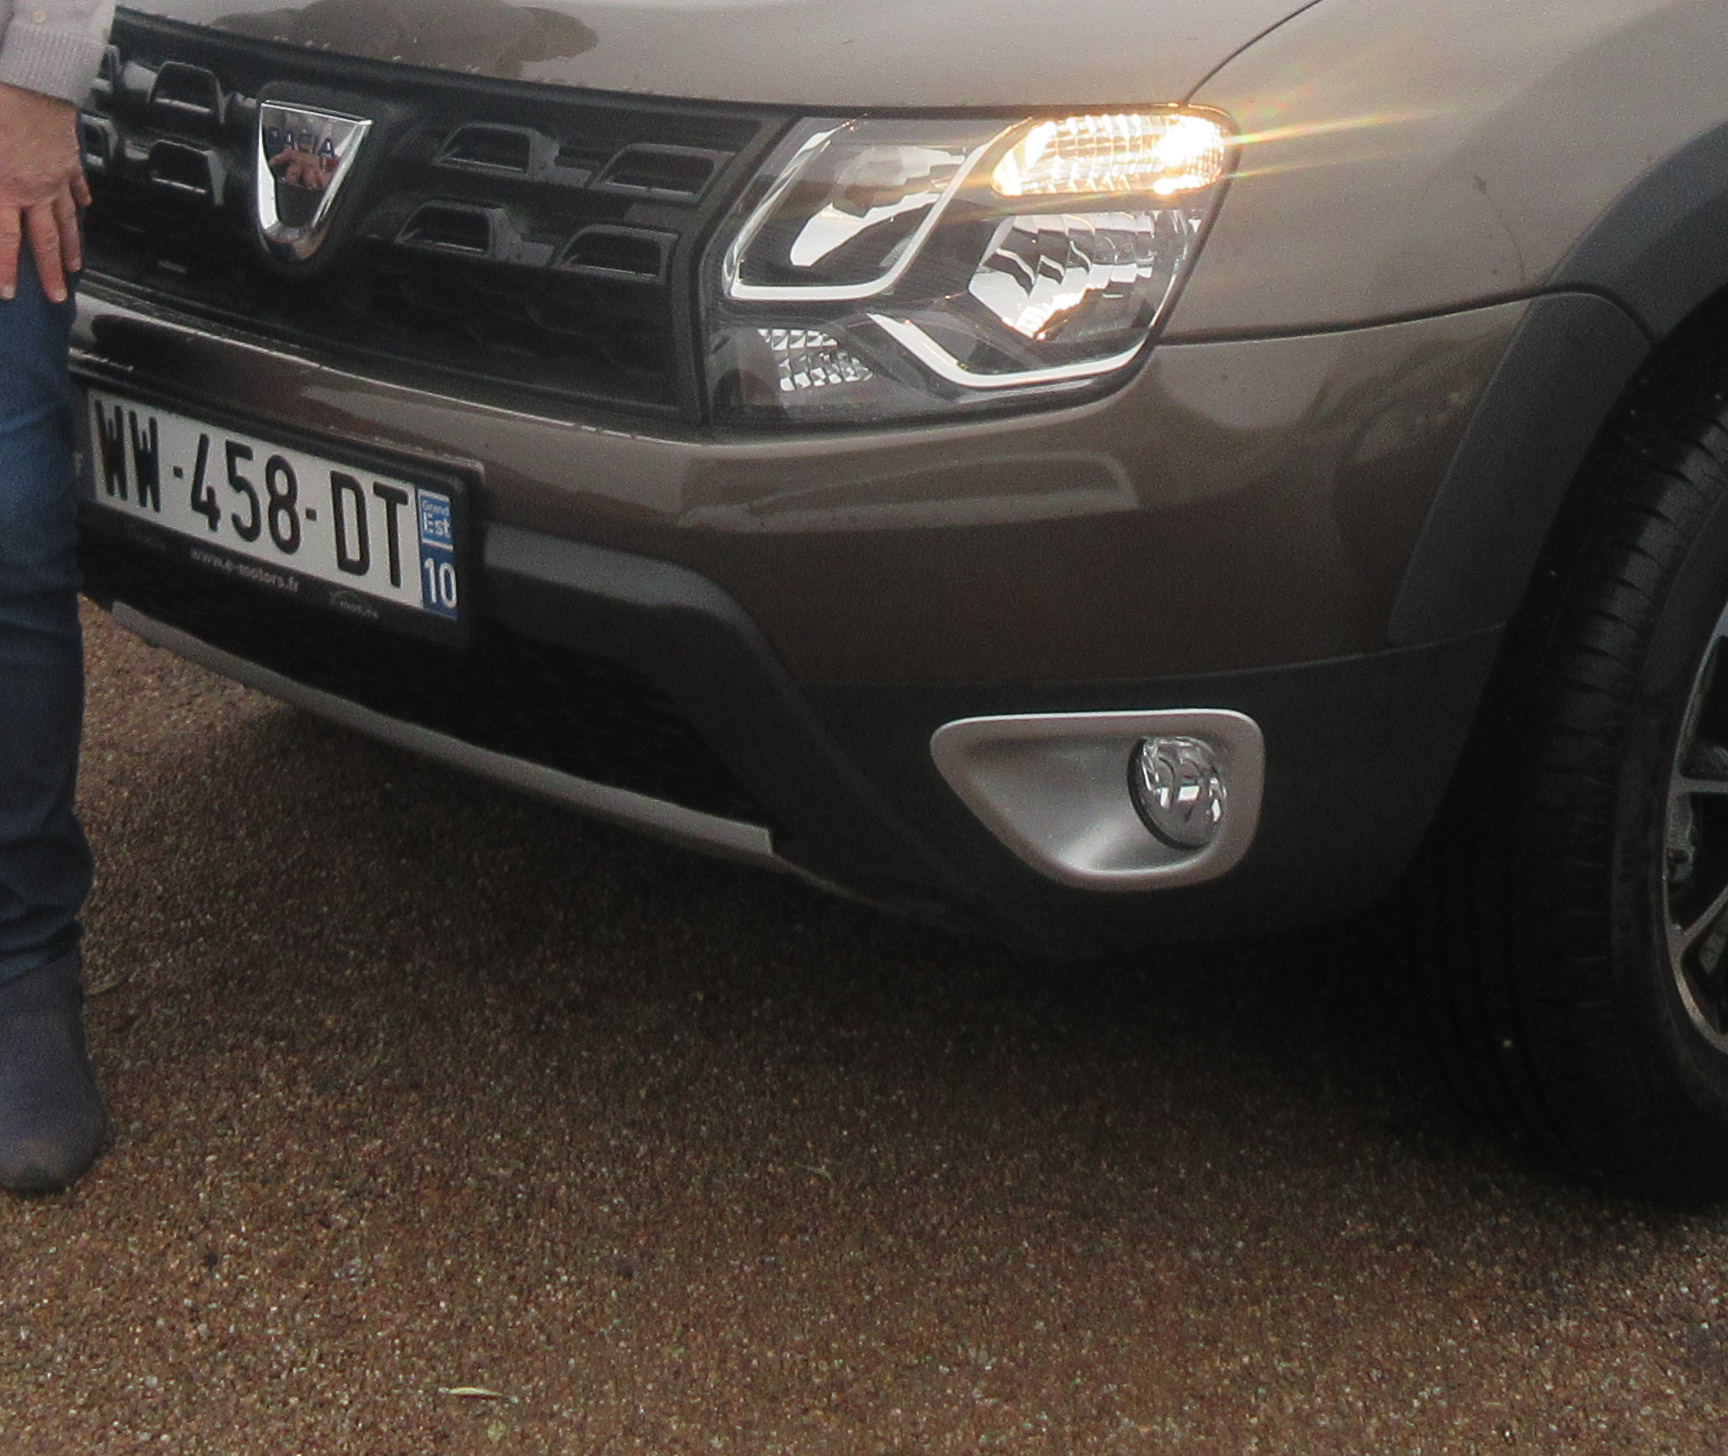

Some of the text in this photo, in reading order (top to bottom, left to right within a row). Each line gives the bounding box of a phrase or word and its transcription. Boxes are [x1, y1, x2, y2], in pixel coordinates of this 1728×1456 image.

[268, 125, 337, 159] DACIA
[94, 399, 408, 588] WW-458-DT
[422, 500, 450, 517] Grand
[422, 511, 451, 538] Est
[190, 546, 299, 594] www.e-motors.fr
[425, 557, 457, 608] 10
